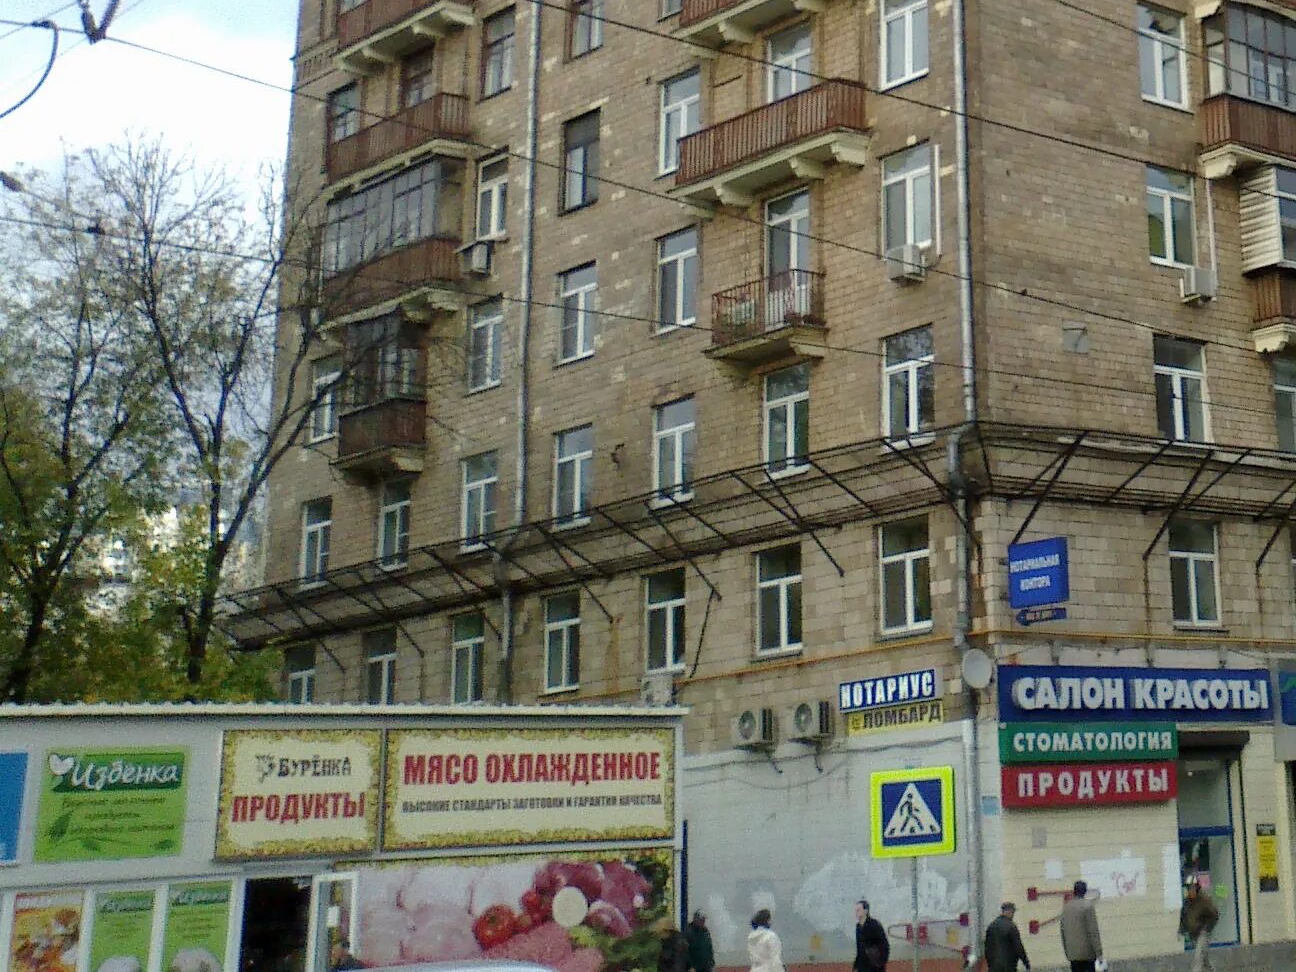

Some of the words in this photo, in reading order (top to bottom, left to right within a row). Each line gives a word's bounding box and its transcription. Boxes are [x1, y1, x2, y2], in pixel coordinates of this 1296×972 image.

[841, 672, 933, 708] НОТАРИУС
[1013, 676, 1126, 711] САЛОН
[1133, 677, 1270, 710] КРАСОТЫ
[863, 702, 941, 729] ЛОМБАРД
[1012, 731, 1172, 752] СТОМАТОЛОГИЯ
[277, 754, 352, 777] БУРЁНКА
[403, 754, 479, 785] МЯСО
[484, 751, 661, 787] ОХЛАЖДЕННОЕ
[1017, 768, 1169, 799] ПРОДУКТЫ
[232, 791, 366, 824] ПРОДУКТЫ
[452, 797, 512, 812] СТАНДАРТЫ
